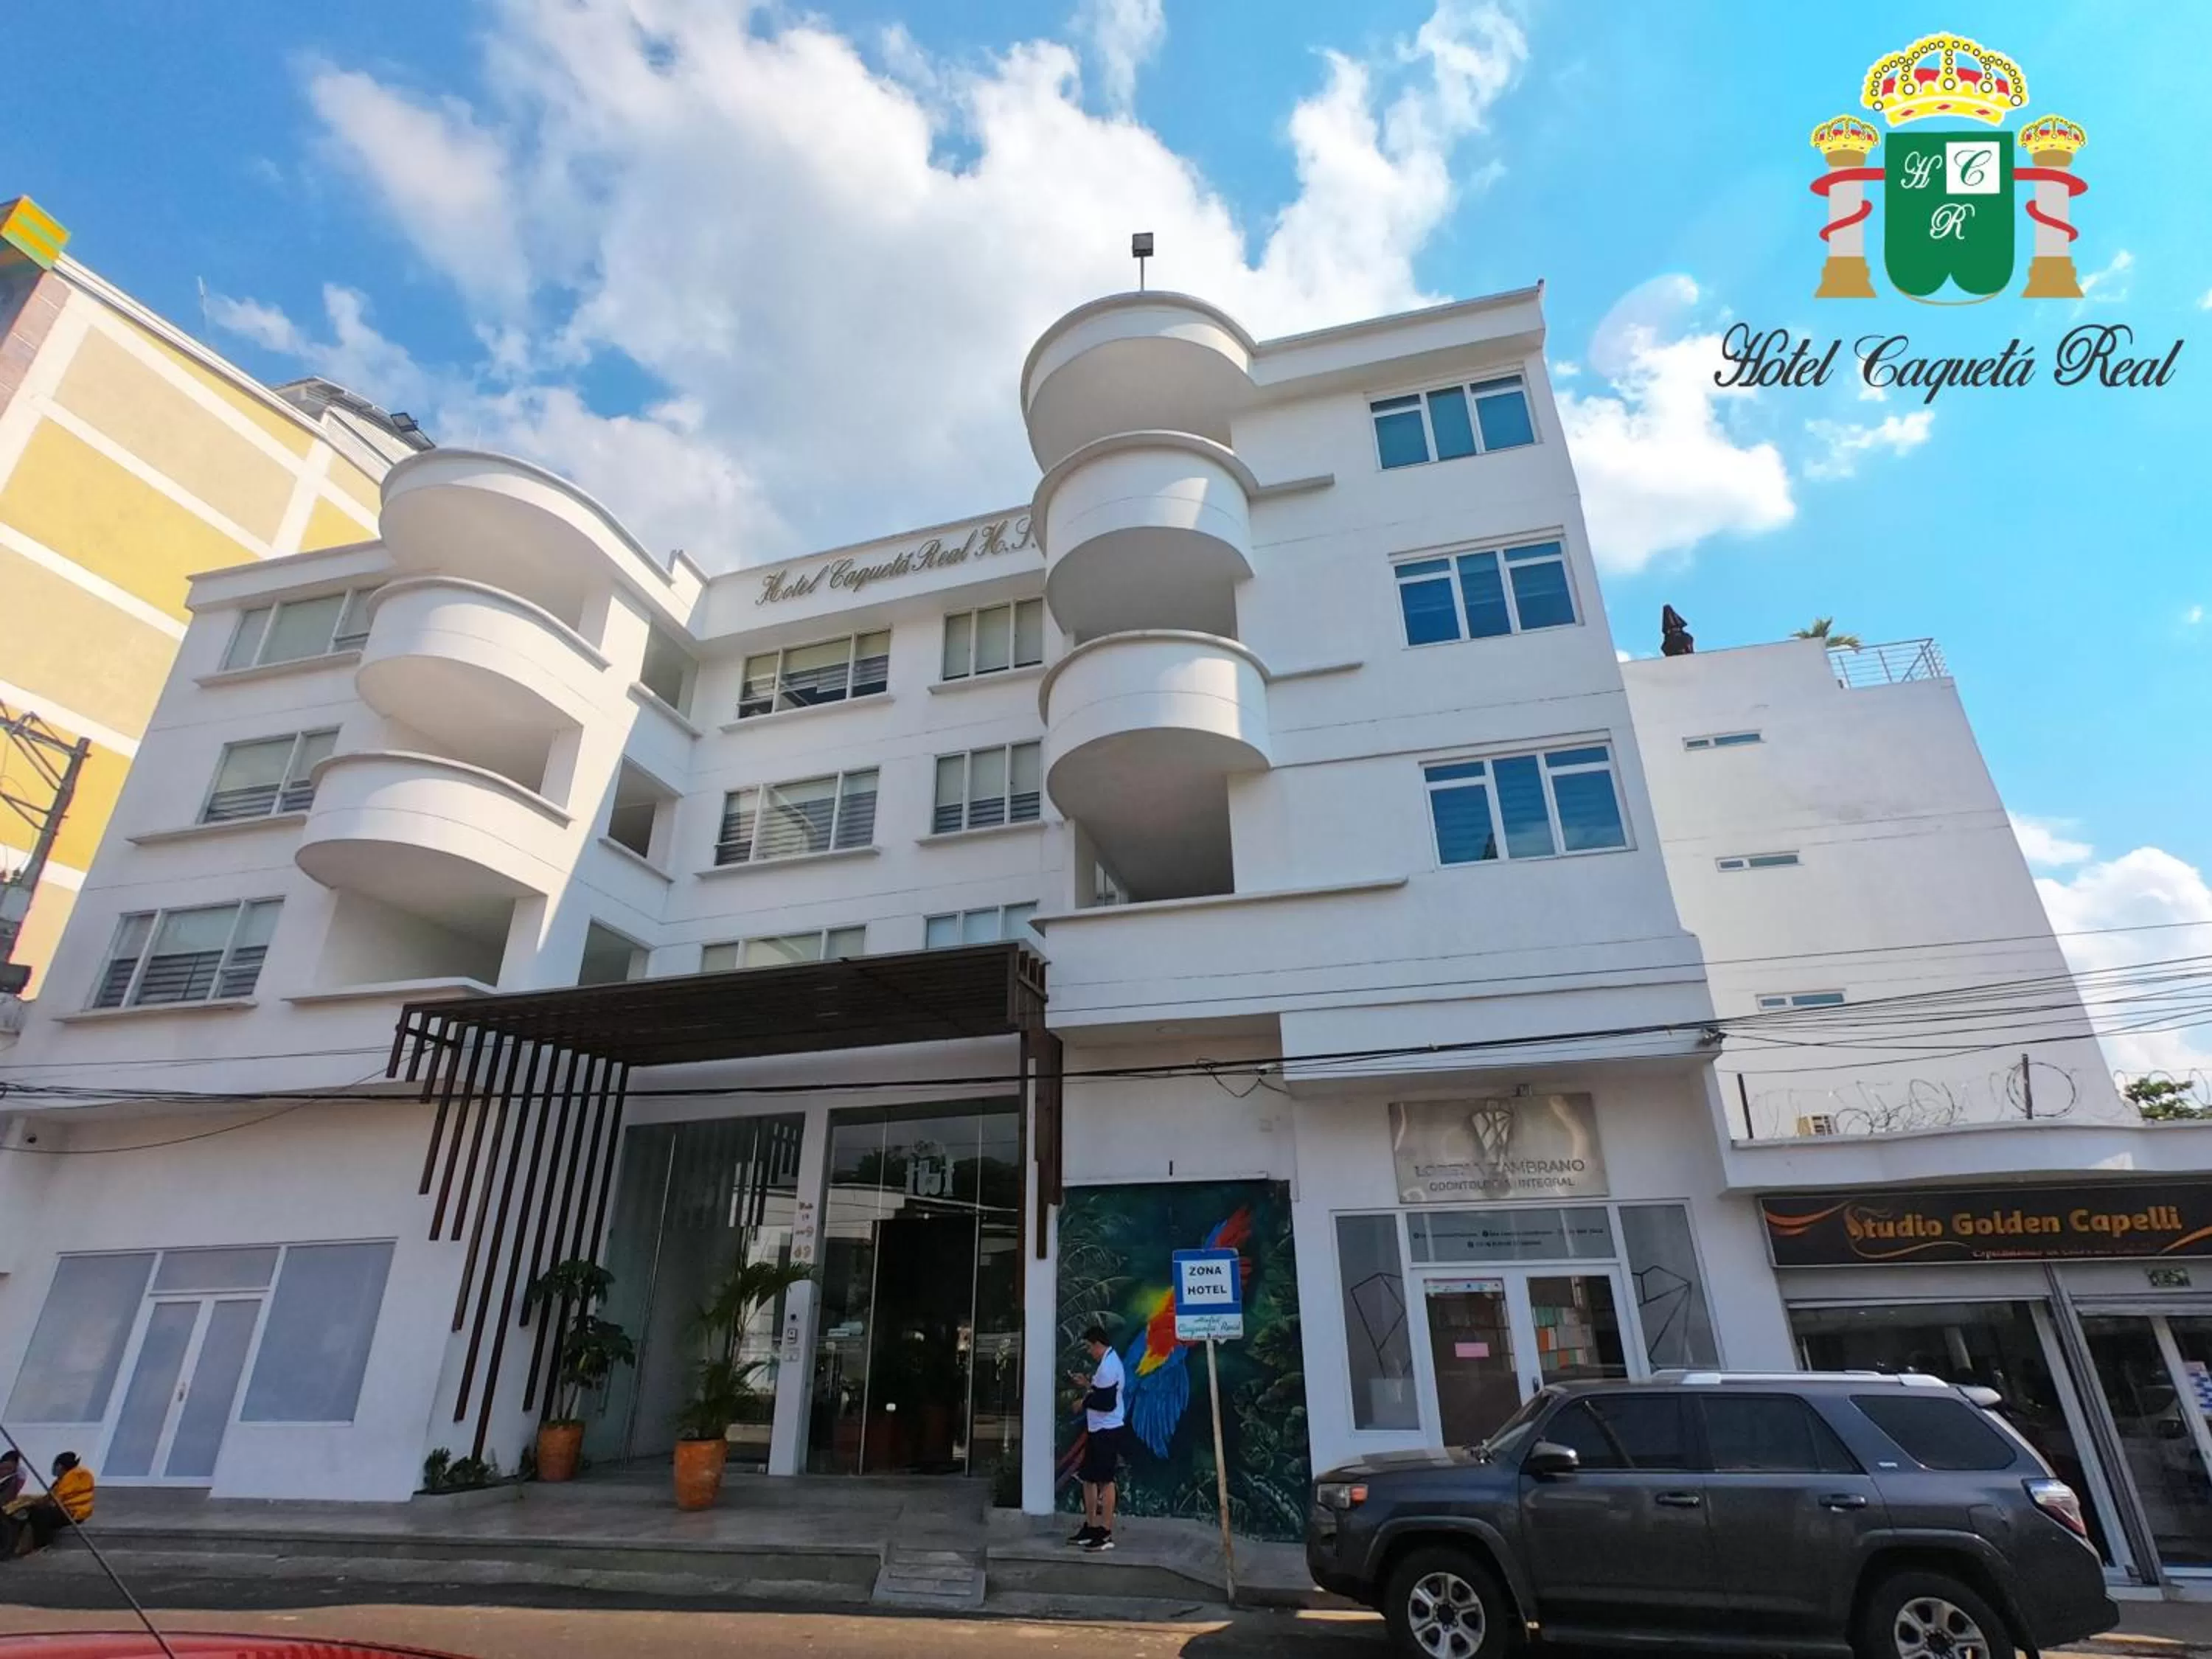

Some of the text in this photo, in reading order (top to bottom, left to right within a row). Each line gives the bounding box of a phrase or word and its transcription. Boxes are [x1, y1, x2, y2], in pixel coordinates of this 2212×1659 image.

[755, 566, 830, 605] Hotel
[911, 529, 978, 571] Real
[1846, 1204, 2183, 1242] Studio Golden Capelli
[1189, 1266, 1222, 1276] ZONA
[1188, 1285, 1227, 1295] HOTEL
